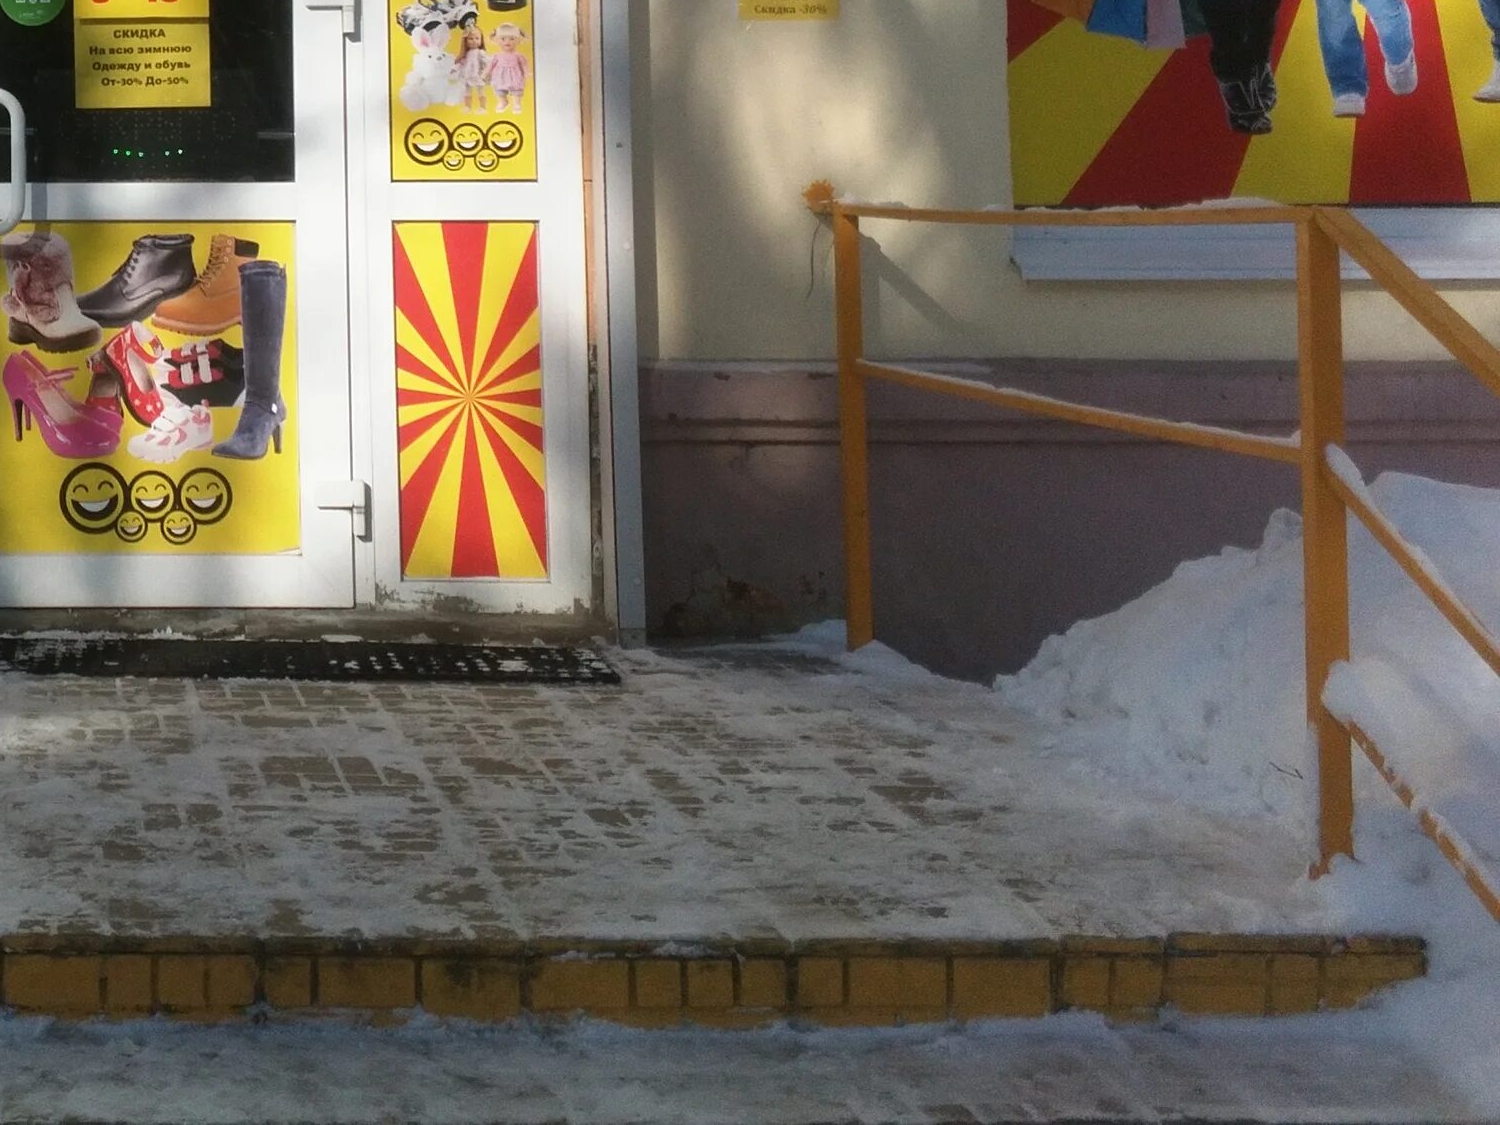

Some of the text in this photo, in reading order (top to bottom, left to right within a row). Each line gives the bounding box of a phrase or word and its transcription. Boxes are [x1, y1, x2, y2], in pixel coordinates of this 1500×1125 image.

[113, 28, 166, 40] СКИДКА
[88, 45, 192, 55] На всю зимнюю
[92, 59, 191, 72] Одежду и обувь
